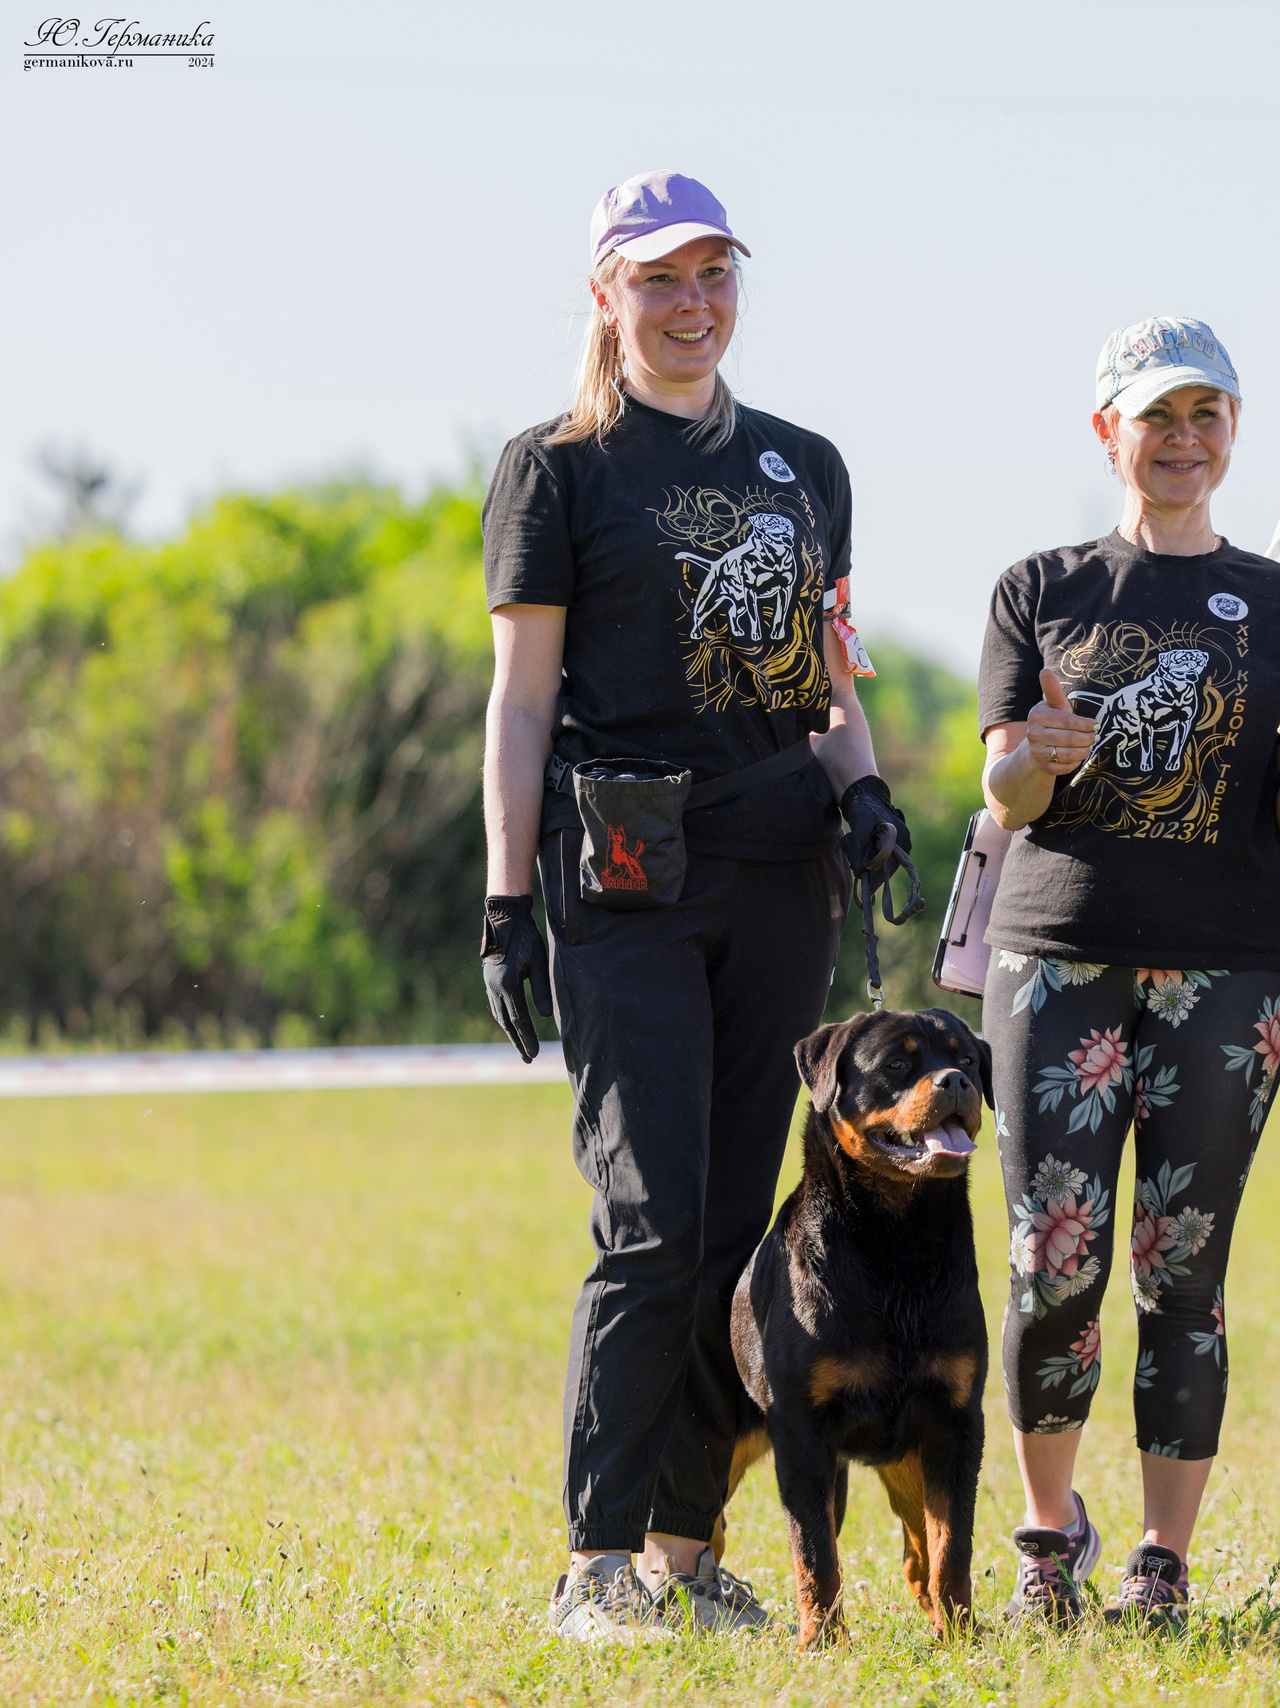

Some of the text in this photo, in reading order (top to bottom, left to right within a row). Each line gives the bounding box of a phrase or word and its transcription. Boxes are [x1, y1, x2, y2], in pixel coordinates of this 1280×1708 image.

[1119, 326, 1218, 370] CHICAGO
[770, 689, 810, 709] 023
[1226, 669, 1249, 747] КУБОК
[1203, 763, 1231, 844] ТВЕРИ
[1132, 819, 1195, 841] 2023
